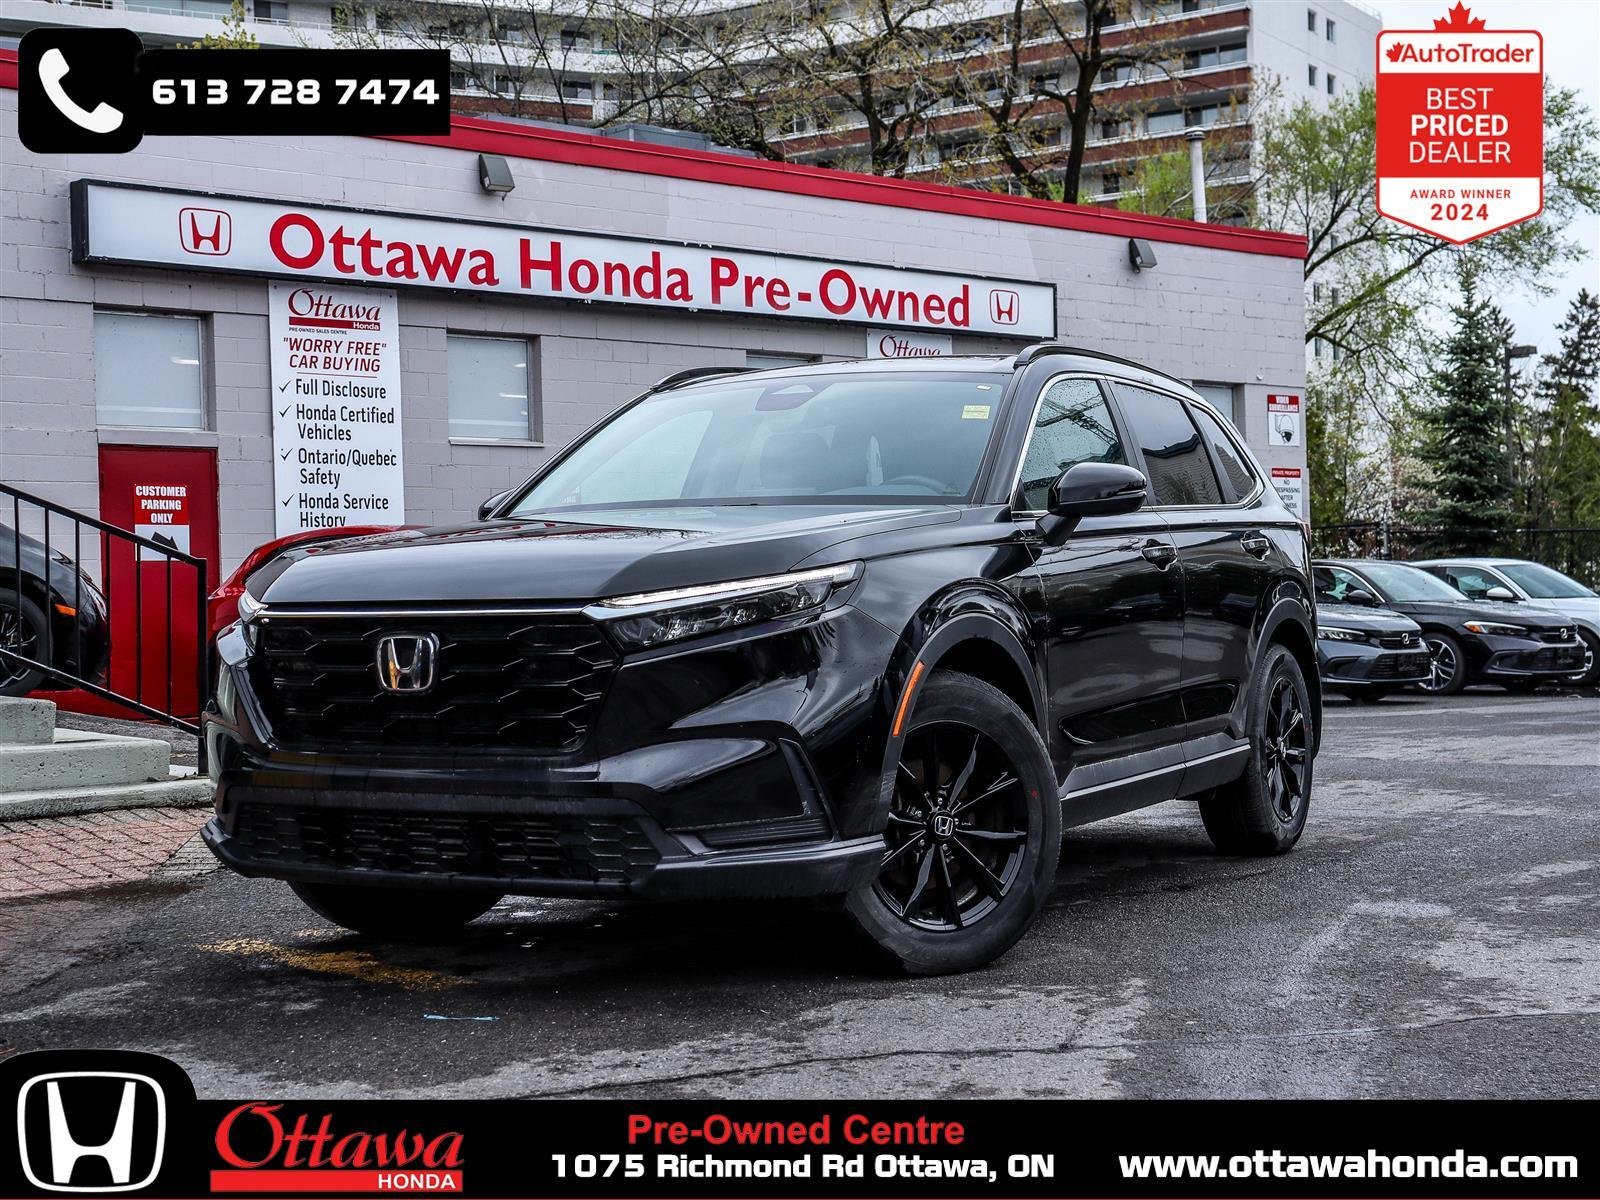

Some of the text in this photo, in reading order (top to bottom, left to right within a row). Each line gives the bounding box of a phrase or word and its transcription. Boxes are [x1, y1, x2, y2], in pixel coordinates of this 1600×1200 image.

[269, 213, 500, 287] Ottawa
[519, 238, 693, 303] Honda
[710, 256, 970, 328] Pre-Owned
[288, 287, 381, 321] Ottawa
[353, 321, 380, 331] Honda
[283, 336, 387, 356] "WORRY FREE"
[880, 334, 941, 358] Ottawa
[289, 354, 381, 373] CAR BUYING
[296, 378, 386, 399] Full Disclosure
[296, 403, 394, 424] Honda Certified
[298, 422, 352, 441] Vehicles
[298, 447, 397, 467] Ontario/Quebec
[300, 467, 341, 489] Safety
[136, 485, 187, 497] CUSTOMER
[141, 499, 182, 511] PARKING
[299, 492, 389, 510] Honda Service
[150, 512, 173, 524] ONLY
[300, 511, 346, 528] History
